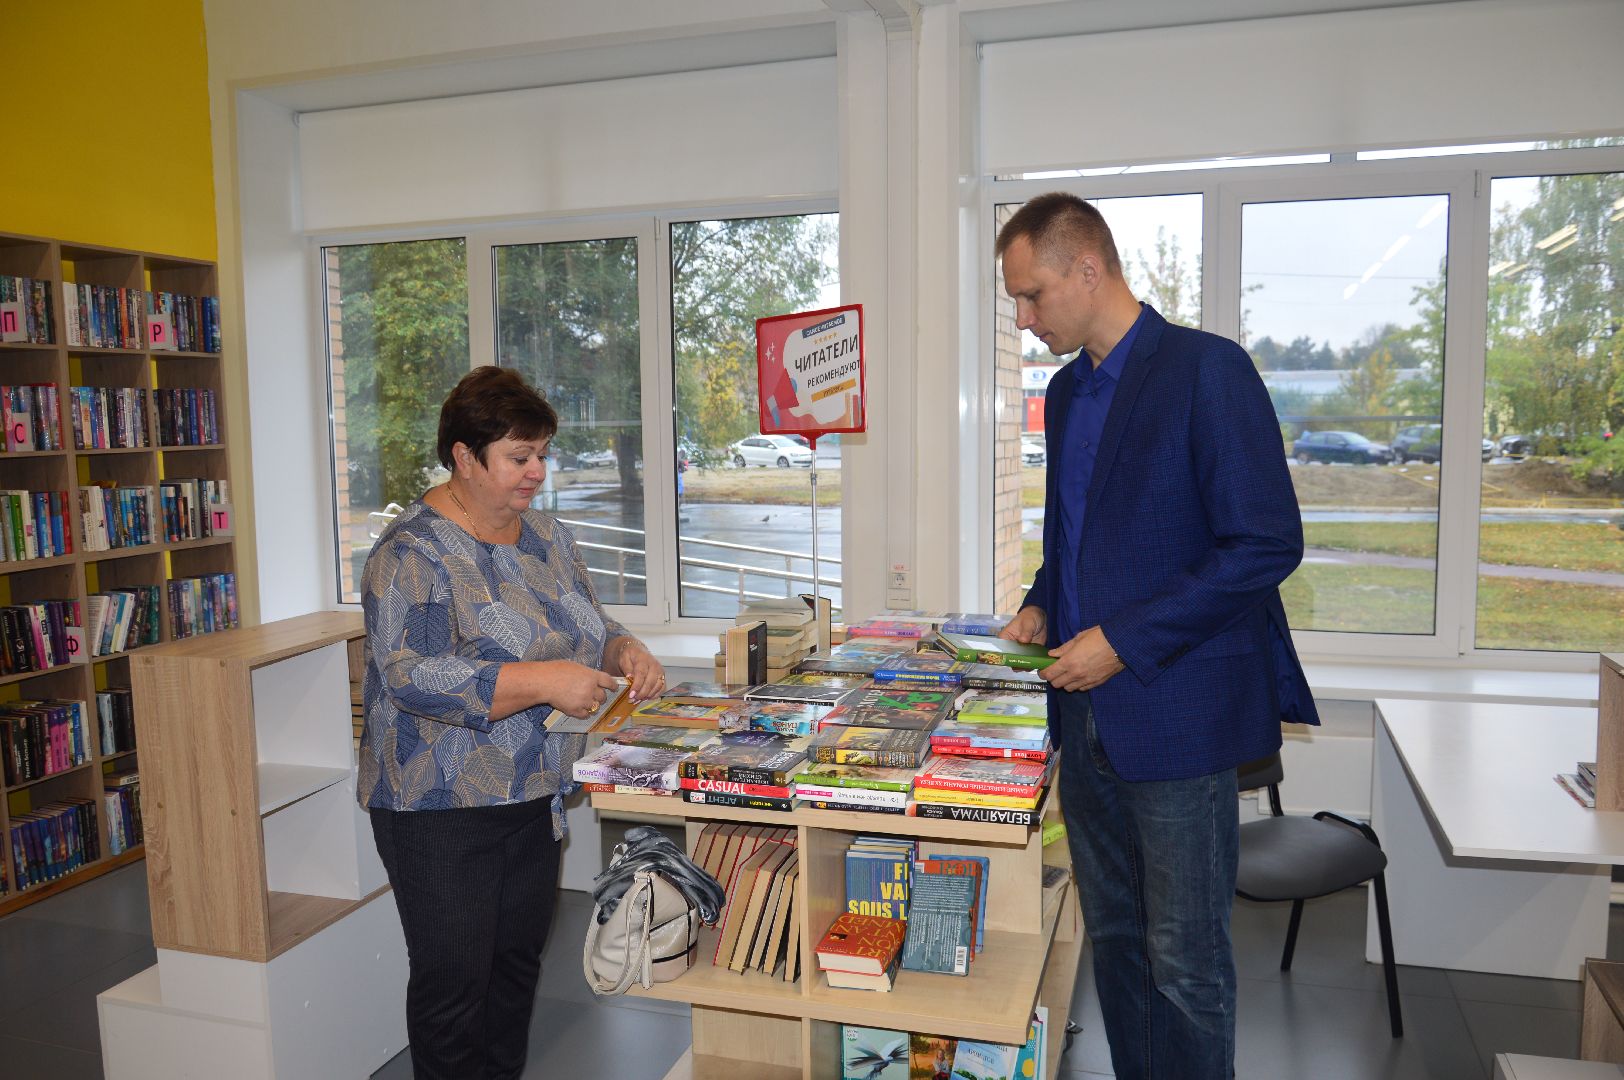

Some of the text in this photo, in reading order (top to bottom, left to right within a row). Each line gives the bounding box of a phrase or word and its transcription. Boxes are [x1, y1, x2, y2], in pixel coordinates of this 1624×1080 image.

[4, 311, 16, 332] П
[795, 334, 858, 373] ЧИТАТЕЛИ
[807, 359, 860, 388] РЕКОМЕНДУЮТ
[214, 512, 225, 529] Т
[66, 635, 79, 655] Ф
[698, 780, 747, 795] CASUAL
[707, 795, 737, 805] АГЕНТ
[849, 899, 892, 919] SOUS
